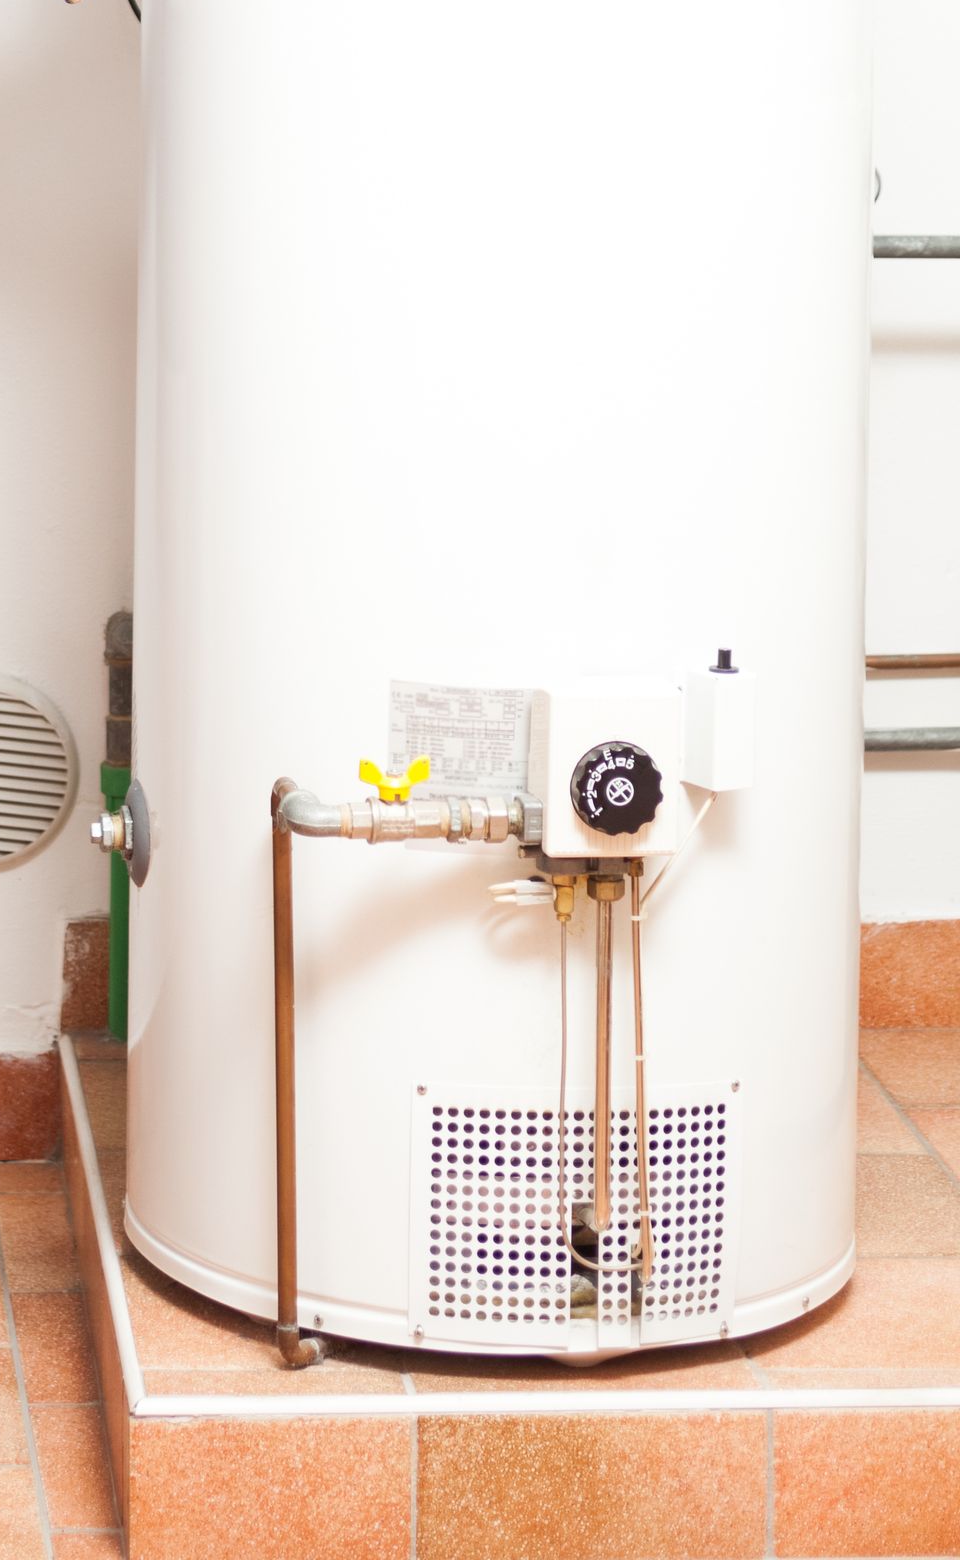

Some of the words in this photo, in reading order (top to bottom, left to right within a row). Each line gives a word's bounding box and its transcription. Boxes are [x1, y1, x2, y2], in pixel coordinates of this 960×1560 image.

[626, 759, 635, 769] 5
[591, 771, 602, 782] 3
[587, 790, 597, 798] 2
